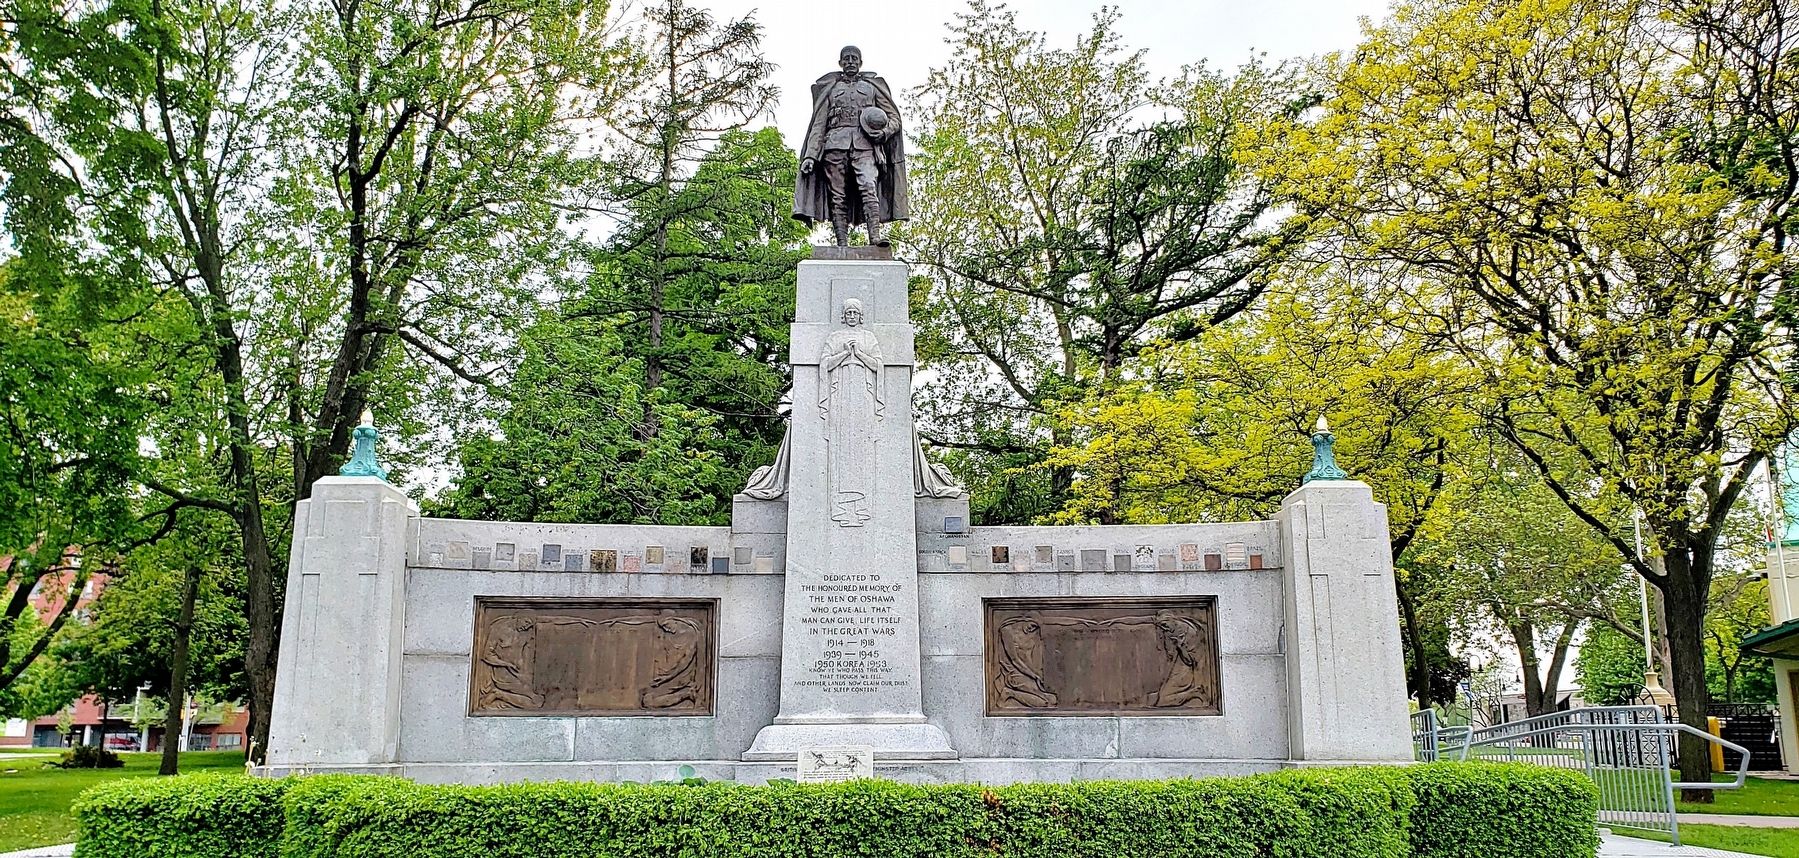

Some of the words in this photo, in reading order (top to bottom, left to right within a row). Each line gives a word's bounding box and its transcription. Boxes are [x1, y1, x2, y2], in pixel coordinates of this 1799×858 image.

[823, 574, 867, 582] DEDICATED
[869, 574, 881, 582] TO
[801, 584, 815, 592] THE
[818, 584, 858, 592] HONOURED
[858, 584, 890, 592] MEMORY
[892, 584, 902, 592] OF
[809, 595, 824, 603] THE
[827, 595, 845, 603] MEN
[847, 595, 858, 603] OF
[860, 595, 895, 603] OSHAWA
[810, 606, 829, 614] WHO
[832, 606, 851, 614] GAVE
[854, 606, 867, 614] ALL
[871, 606, 891, 614] THAT
[801, 616, 818, 624] MAN
[820, 616, 835, 624] CAN
[859, 616, 874, 624] LIFE
[877, 616, 902, 624] ITSELF
[809, 627, 818, 635] IN
[822, 627, 838, 635] THE
[839, 627, 869, 636] GREAT
[871, 627, 896, 636] WARS
[827, 639, 844, 648] 1914
[860, 639, 875, 648] 1918
[823, 650, 842, 660] 1939
[858, 650, 879, 660] 1945
[814, 660, 834, 669] 1950
[836, 660, 865, 668] KOREA
[867, 660, 887, 668] 1953
